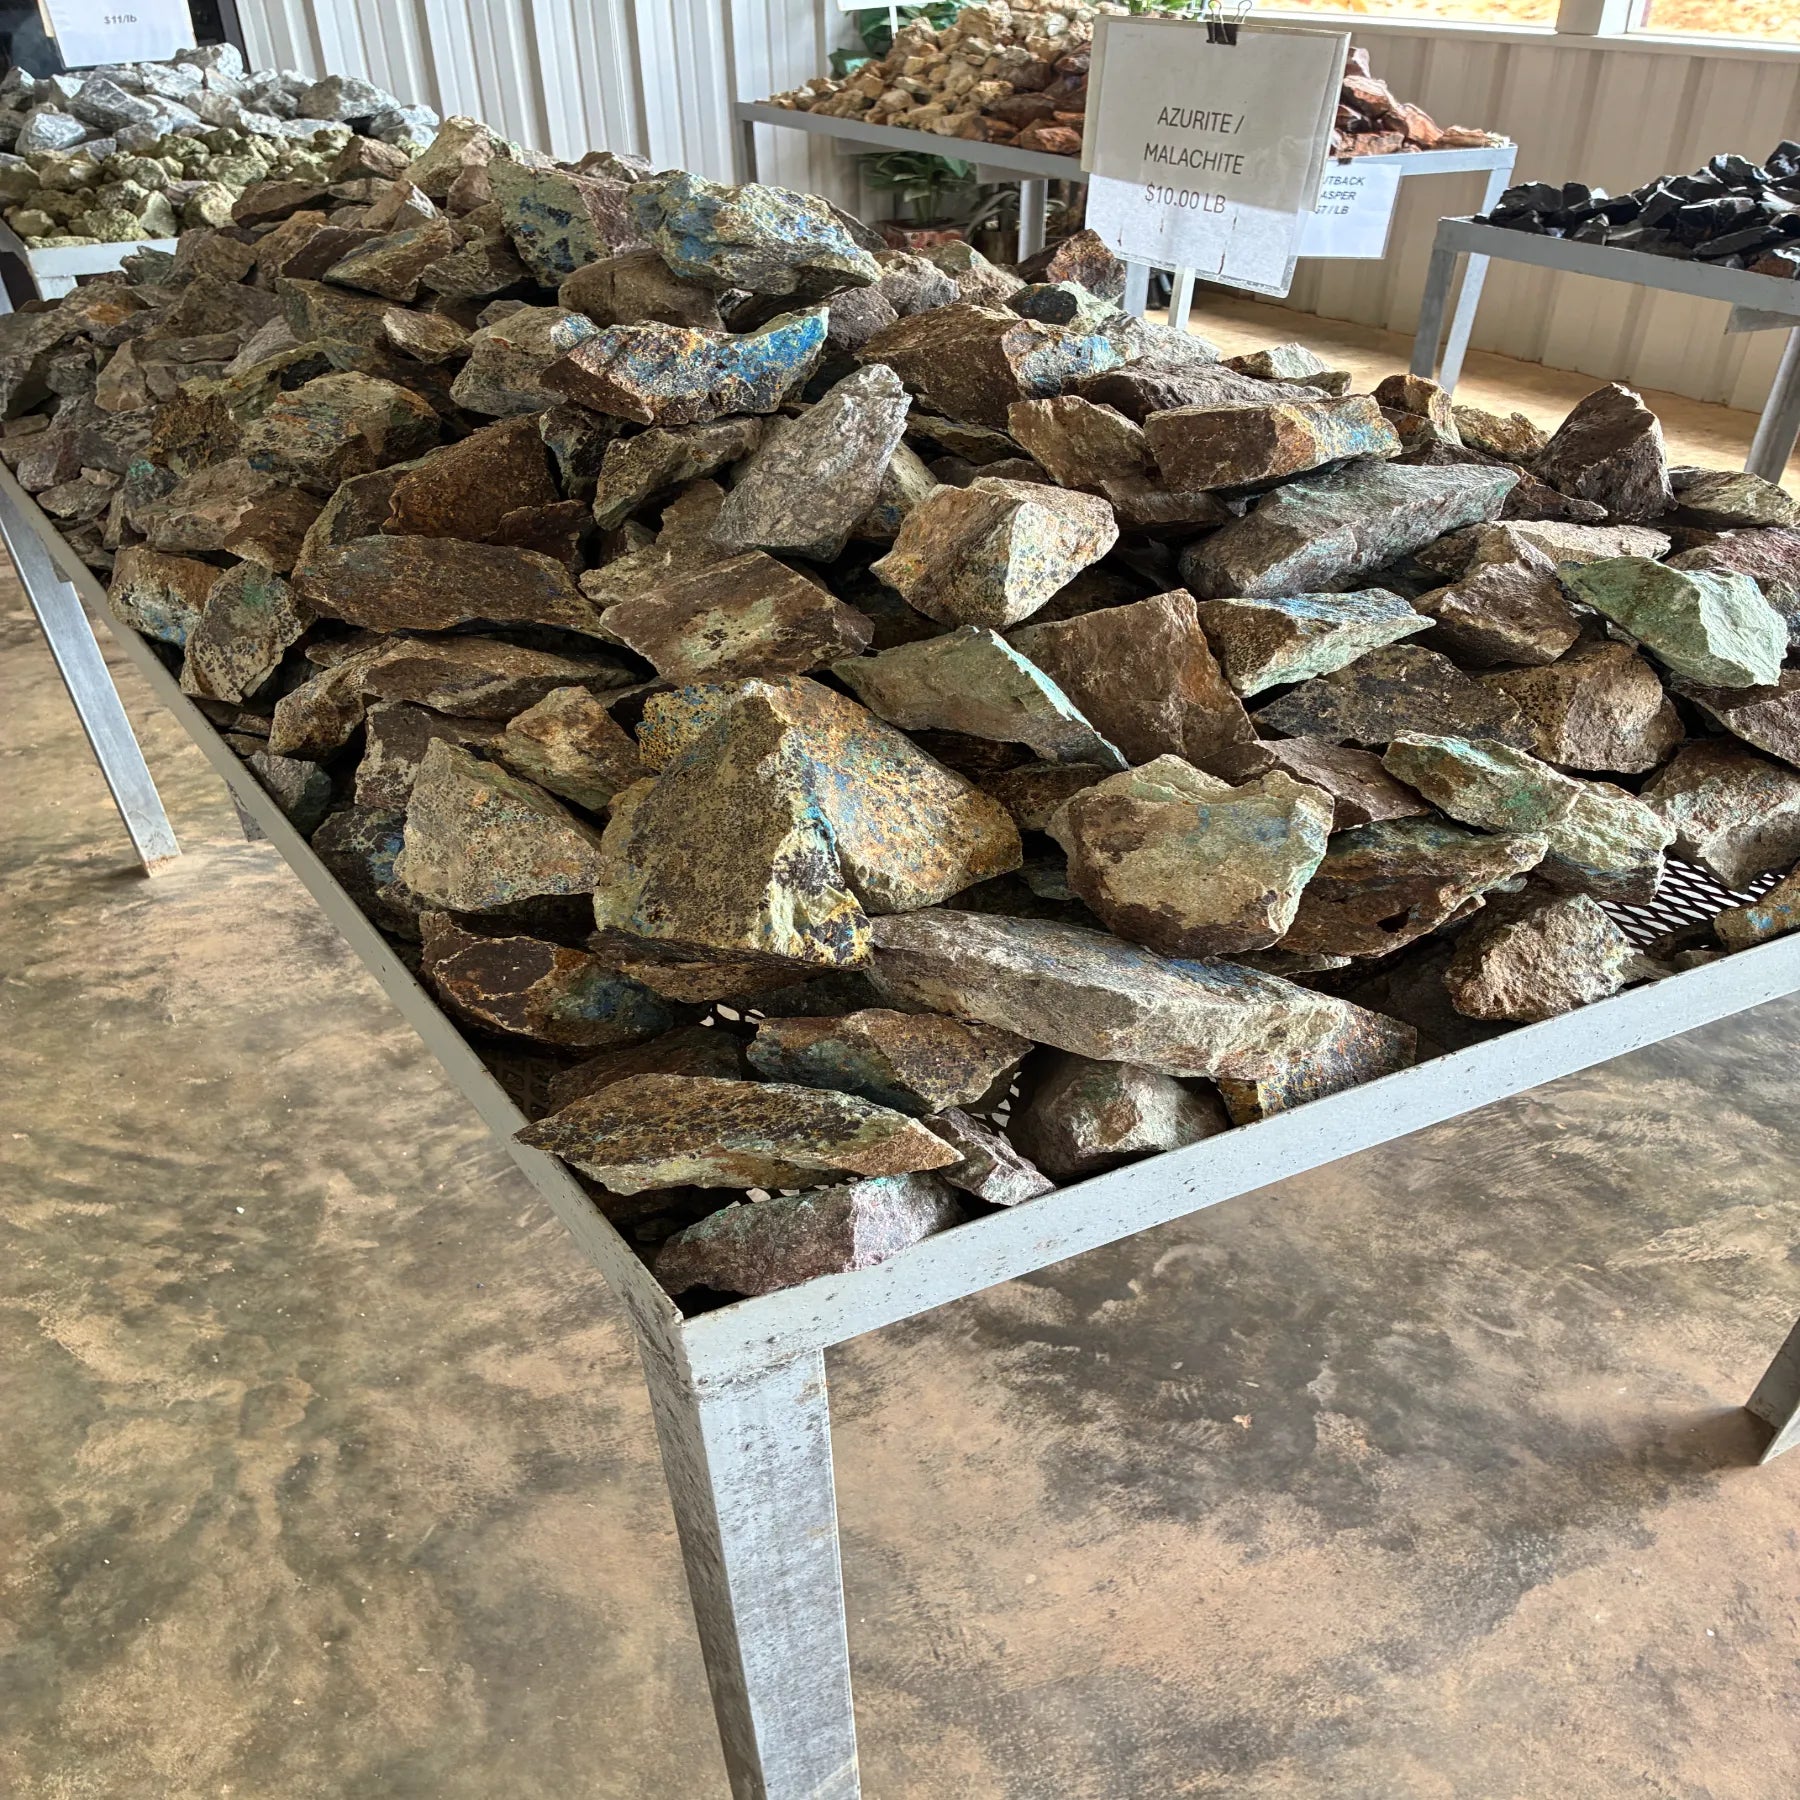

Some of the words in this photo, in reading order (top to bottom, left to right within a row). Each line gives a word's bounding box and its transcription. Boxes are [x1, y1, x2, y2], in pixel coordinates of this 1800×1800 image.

[104, 14, 137, 25] $11/lb
[1144, 142, 1245, 175] MALACHITE
[1145, 182, 1200, 210] $10.00
[1203, 193, 1226, 214] LB
[1320, 190, 1357, 201] ASPER
